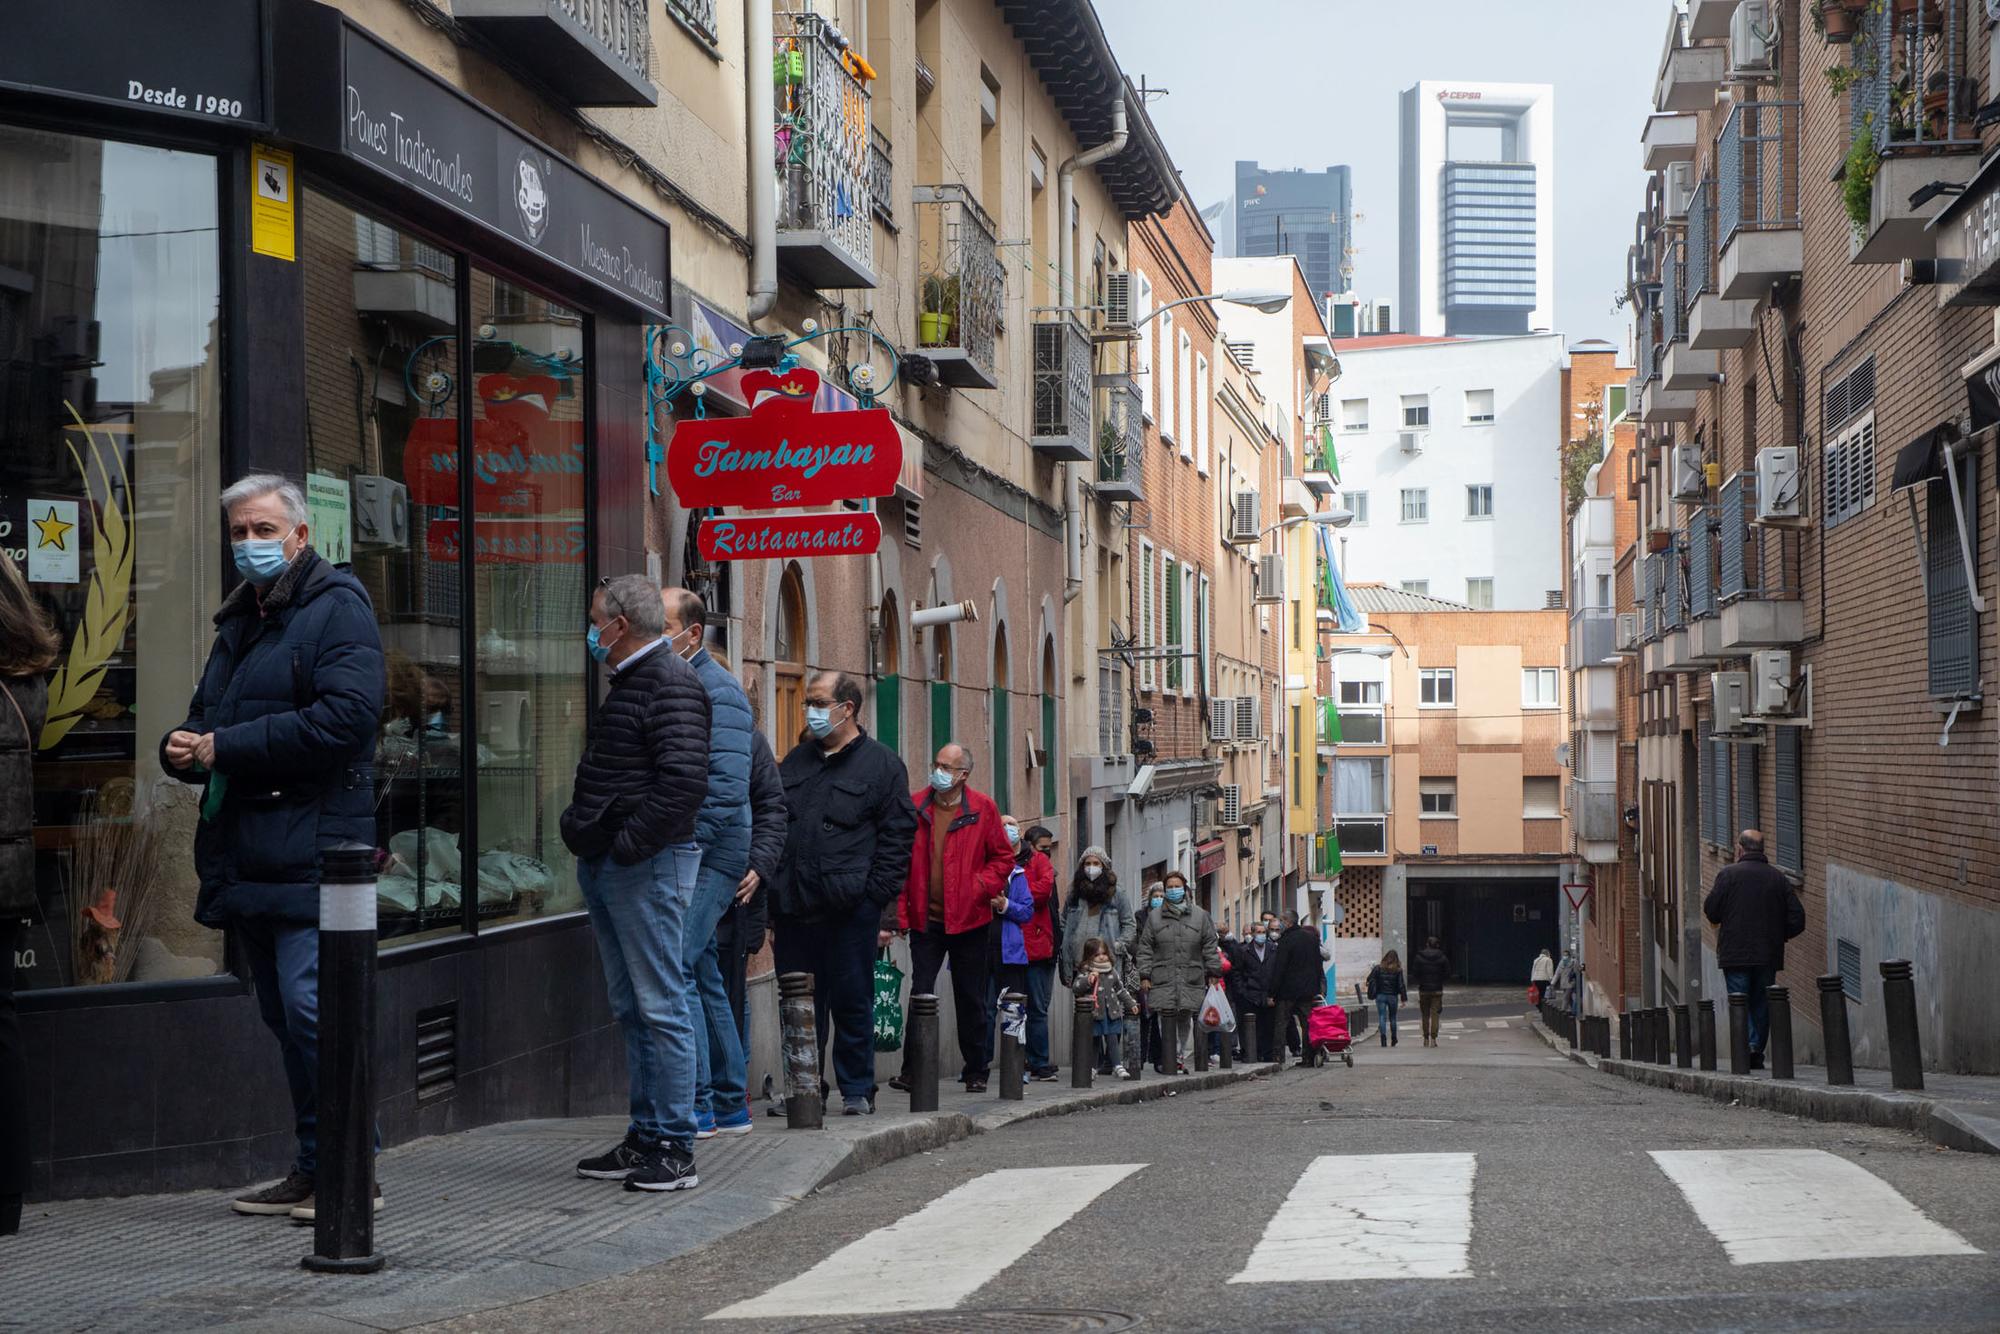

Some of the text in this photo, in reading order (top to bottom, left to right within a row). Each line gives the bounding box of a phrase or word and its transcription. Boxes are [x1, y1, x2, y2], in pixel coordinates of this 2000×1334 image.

[128, 80, 242, 118] Desde 1980
[1450, 91, 1481, 100] CEPSA
[348, 85, 473, 203] Panes Tradicionales
[1243, 198, 1260, 209] pwc
[581, 223, 664, 304] Maestros Panaderos
[694, 438, 875, 479] Tambayan
[771, 485, 802, 502] Bar
[713, 523, 863, 554] Restaurante
